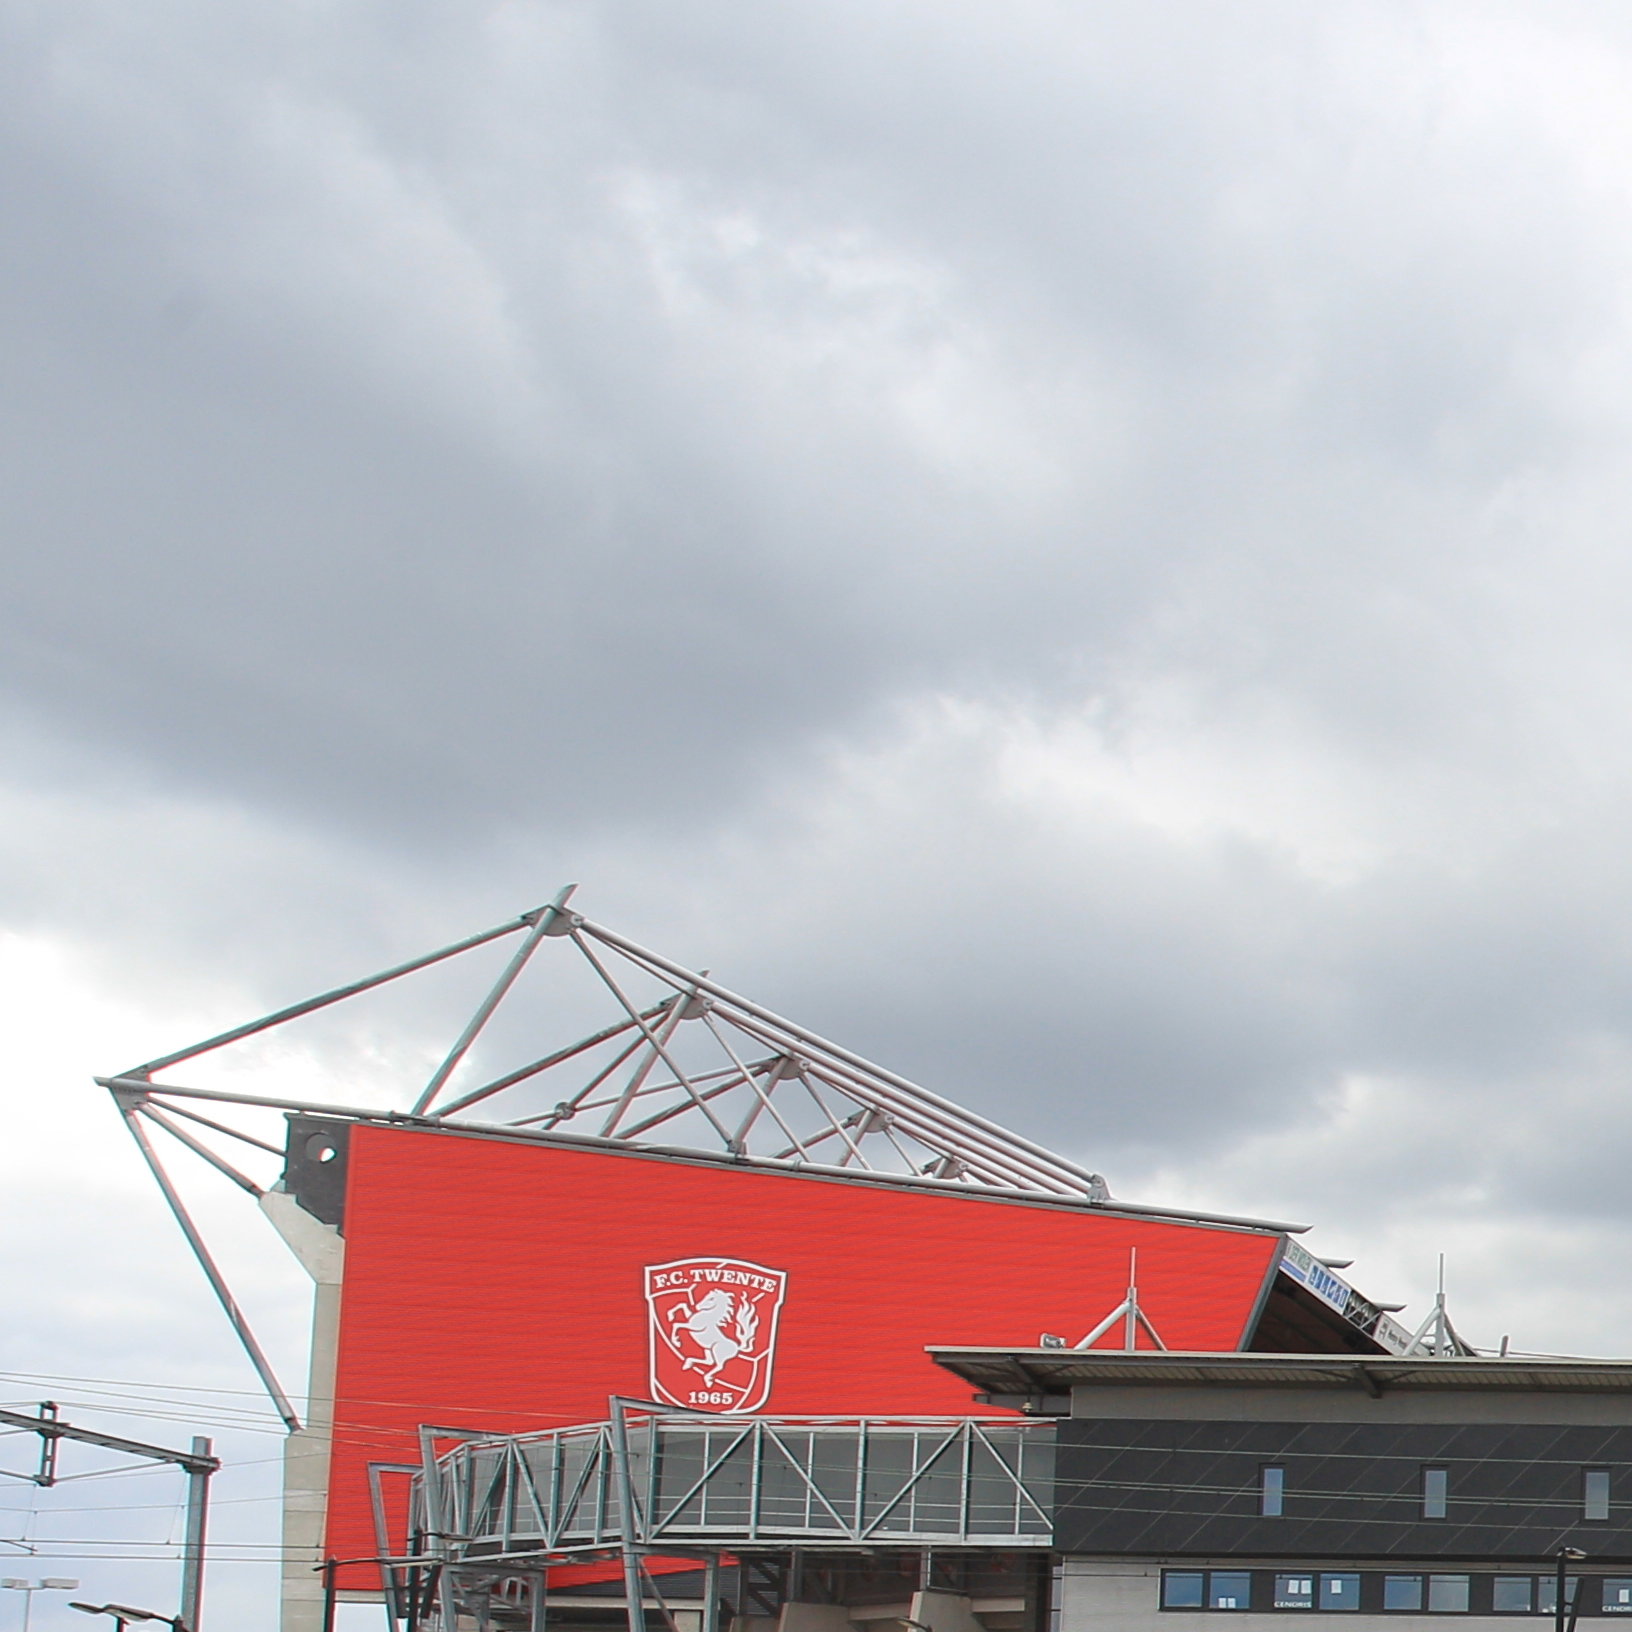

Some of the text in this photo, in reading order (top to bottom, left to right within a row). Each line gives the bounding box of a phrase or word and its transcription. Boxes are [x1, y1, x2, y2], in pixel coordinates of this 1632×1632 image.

[654, 1269, 777, 1292] F.C. TWENTE
[688, 1391, 733, 1405] 1965
